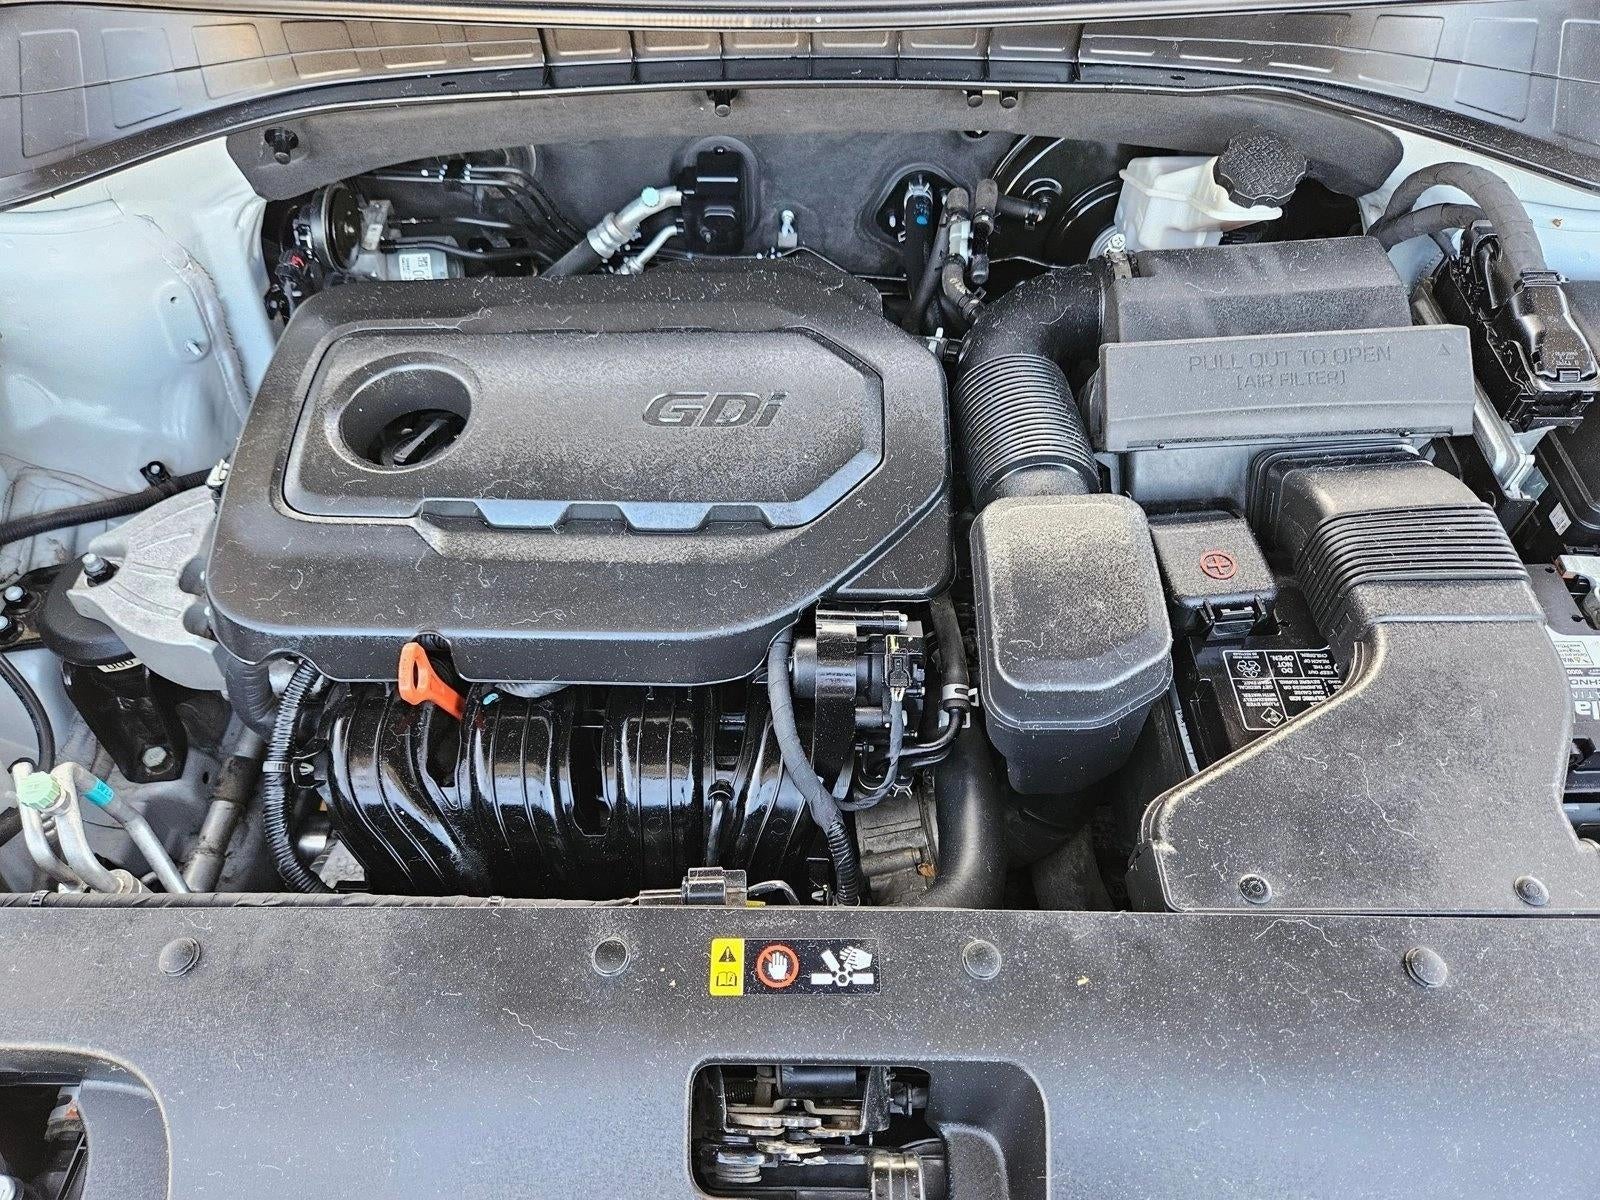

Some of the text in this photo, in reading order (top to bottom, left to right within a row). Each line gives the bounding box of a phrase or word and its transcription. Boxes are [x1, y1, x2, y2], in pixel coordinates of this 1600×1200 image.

[1189, 346, 1391, 371] PULL OUT TO OPEN
[642, 391, 789, 428] GDi
